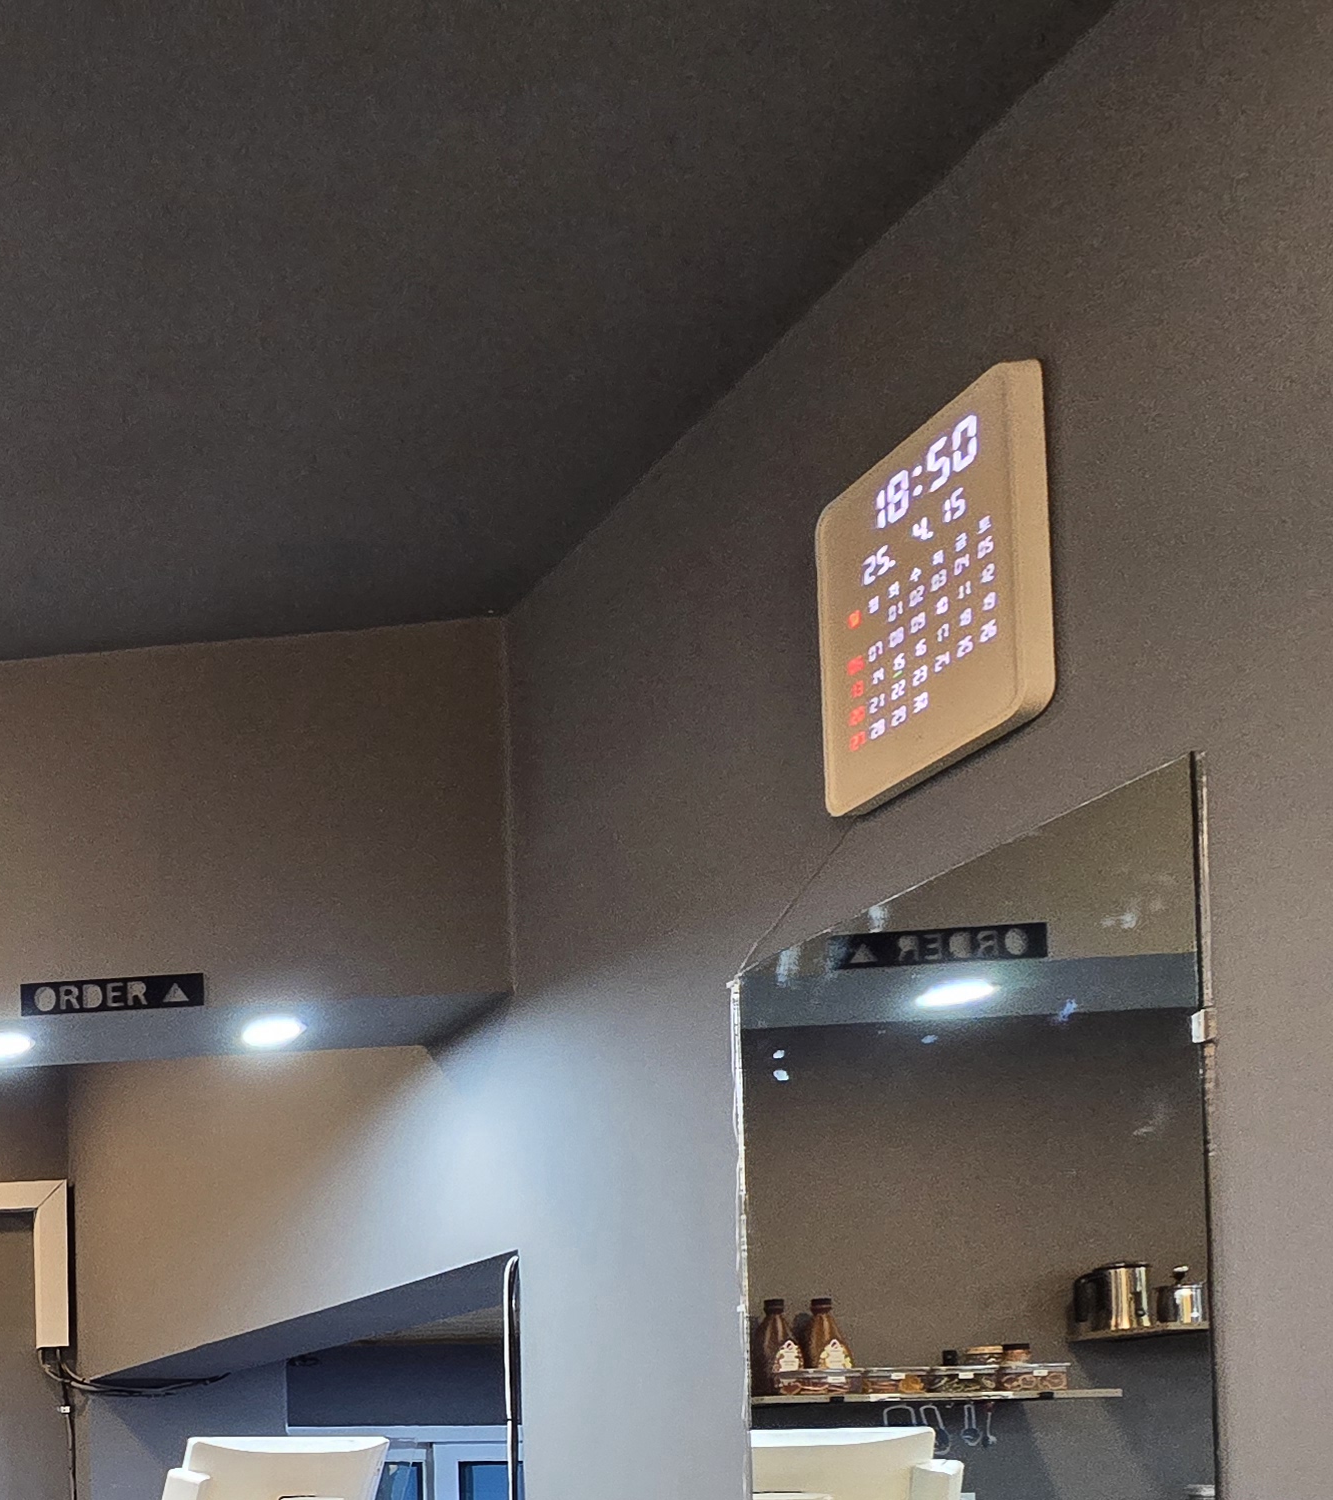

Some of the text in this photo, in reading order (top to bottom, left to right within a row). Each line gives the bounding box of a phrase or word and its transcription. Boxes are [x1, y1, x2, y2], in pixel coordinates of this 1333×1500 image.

[876, 414, 978, 529] 18:50
[943, 487, 966, 523] 15
[33, 980, 148, 1012] ORDER
